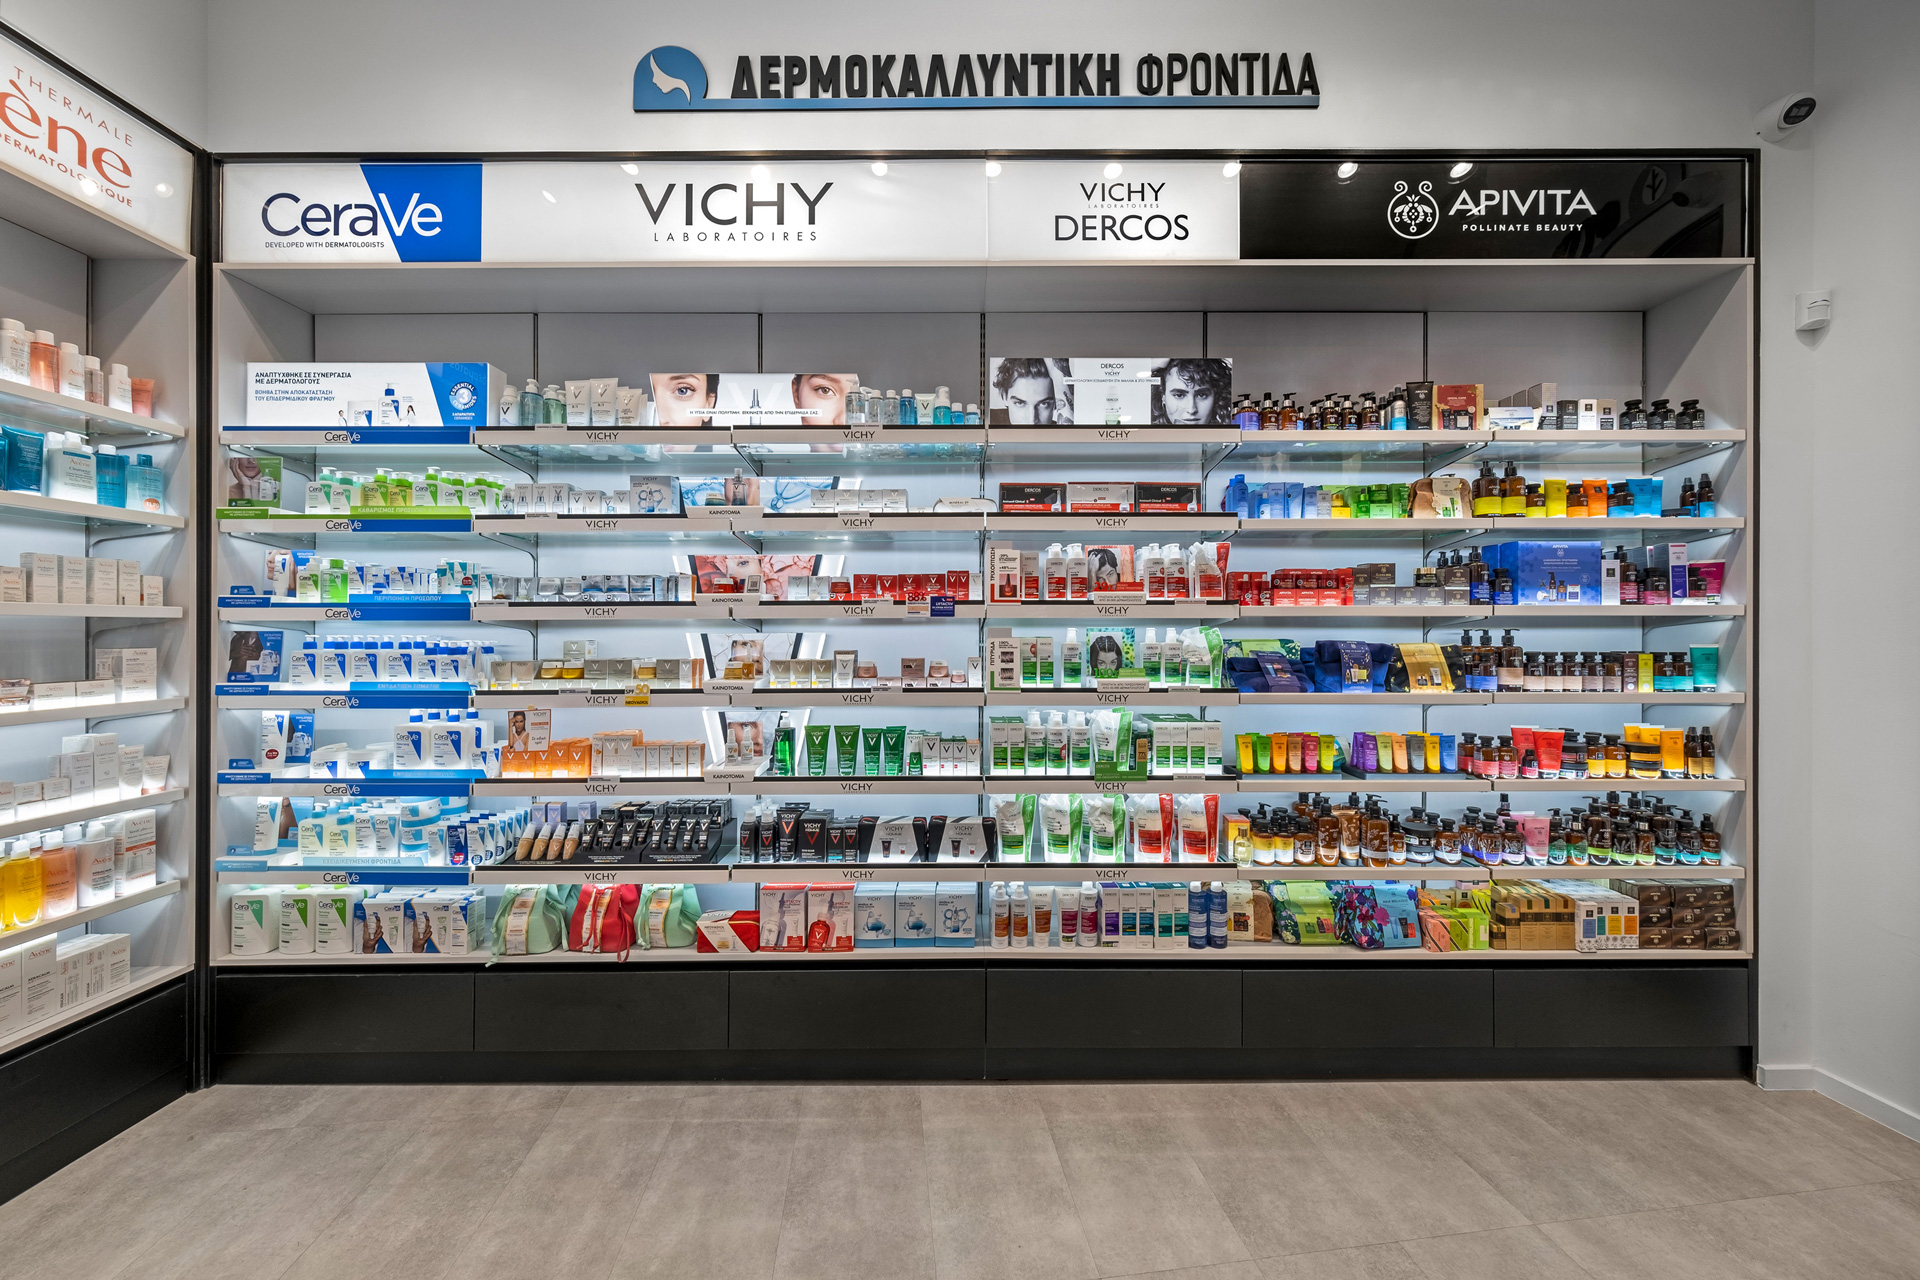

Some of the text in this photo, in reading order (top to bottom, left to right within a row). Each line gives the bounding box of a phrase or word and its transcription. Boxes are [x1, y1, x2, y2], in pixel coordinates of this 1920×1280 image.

[730, 52, 1320, 99] ΔΕΡΜΟΚΑΛΛΥΝΤΙΚΗ ΦΡΟΝΤΙΔΑ
[14, 66, 133, 147] THERMALE
[0, 133, 133, 207] ERMATOLOIQUE
[1080, 182, 1166, 202] VICHY
[635, 182, 834, 225] VICHY
[1448, 189, 1597, 217] APIVITA
[262, 192, 443, 237] CeraVe
[1054, 214, 1190, 241] DERCOS
[1462, 224, 1584, 232] POLLINATE BEAUTY
[654, 231, 817, 242] LABORATOIRES
[460, 390, 469, 400] 3
[324, 431, 361, 441] CeraVe
[586, 432, 619, 440] VICHY
[843, 430, 875, 439] VICHY
[1098, 430, 1131, 438] VICHY
[325, 519, 361, 530] CeraVe
[585, 520, 618, 528] VICHY
[842, 518, 875, 527] VICHY
[1096, 518, 1128, 526] VICHY
[325, 608, 361, 618] CeraVe
[584, 607, 618, 616] VICHY
[843, 606, 875, 614] VICHY
[1097, 606, 1129, 614] VICHY
[635, 684, 649, 695] 50
[323, 696, 359, 706] CeraVe
[585, 696, 618, 704] VICHY
[841, 694, 875, 703] VICHY
[1097, 694, 1129, 702] VICHY
[396, 733, 419, 741] CeraVe
[434, 733, 459, 741] CeraVe
[323, 784, 360, 794] CeraVe
[585, 784, 617, 792] VICHY
[840, 783, 873, 791] VICHY
[1095, 782, 1127, 790] VICHY
[323, 872, 360, 882] CeraVe
[584, 872, 617, 881] VICHY
[842, 870, 875, 879] VICHY
[1095, 870, 1128, 878] VICHY
[234, 902, 260, 911] CeraVe
[281, 901, 305, 909] CeraVe
[318, 901, 344, 909] CeraVe
[28, 947, 52, 960] Avène
